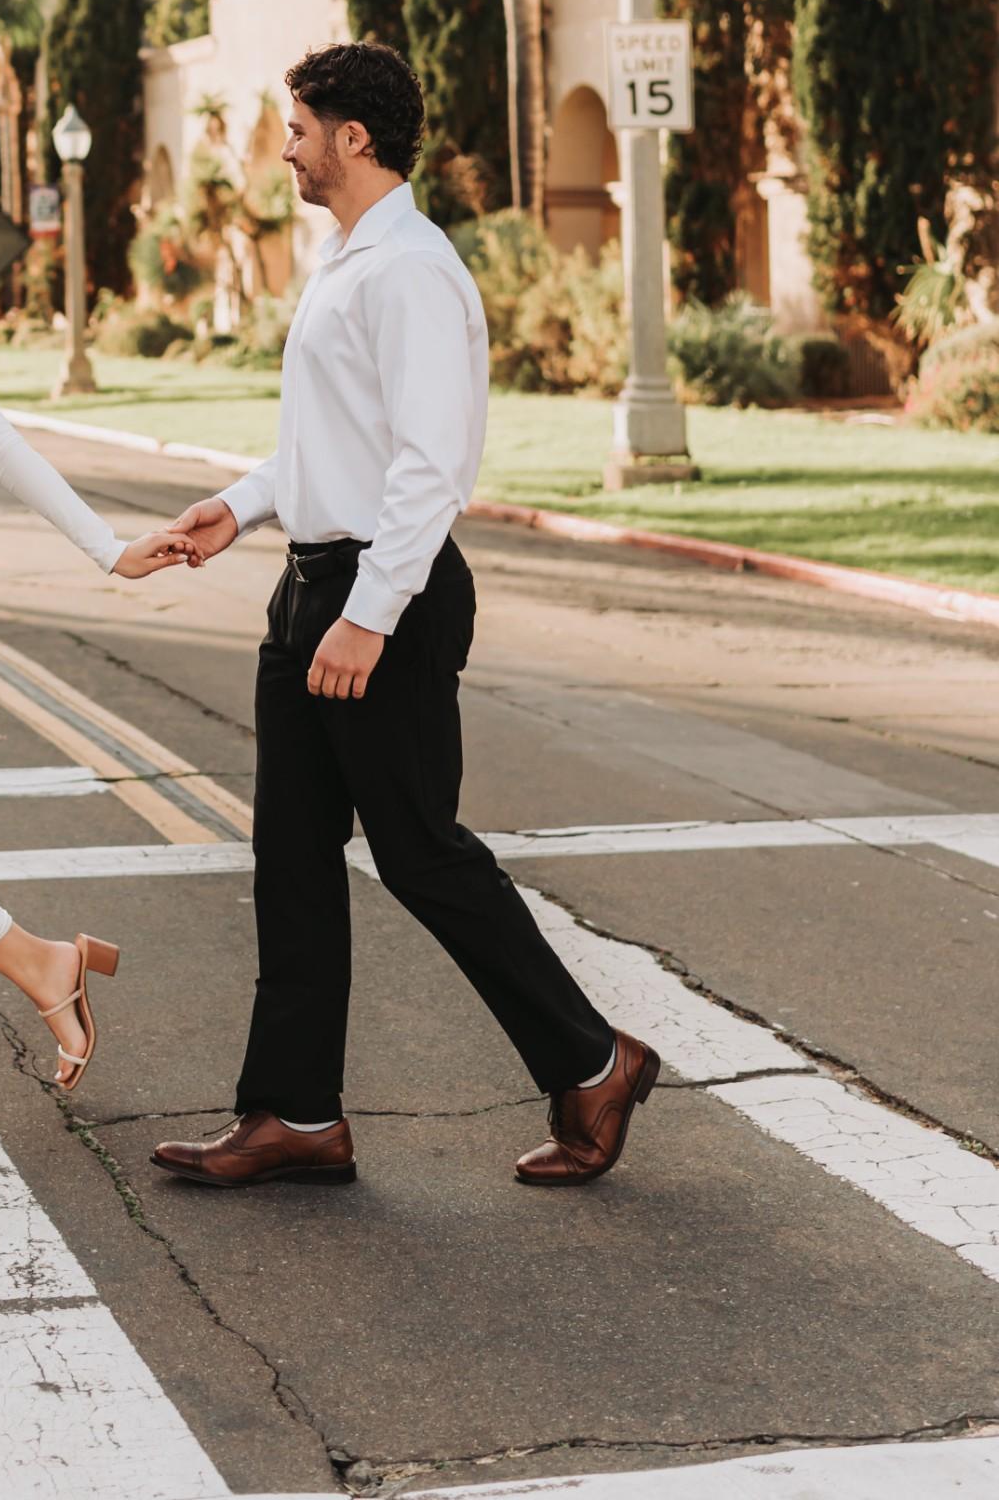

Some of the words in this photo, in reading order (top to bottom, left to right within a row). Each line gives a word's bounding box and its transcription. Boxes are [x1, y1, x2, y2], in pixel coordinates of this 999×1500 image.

[616, 34, 681, 50] SPEED
[622, 58, 674, 73] LIMIT
[626, 79, 674, 116] 15
